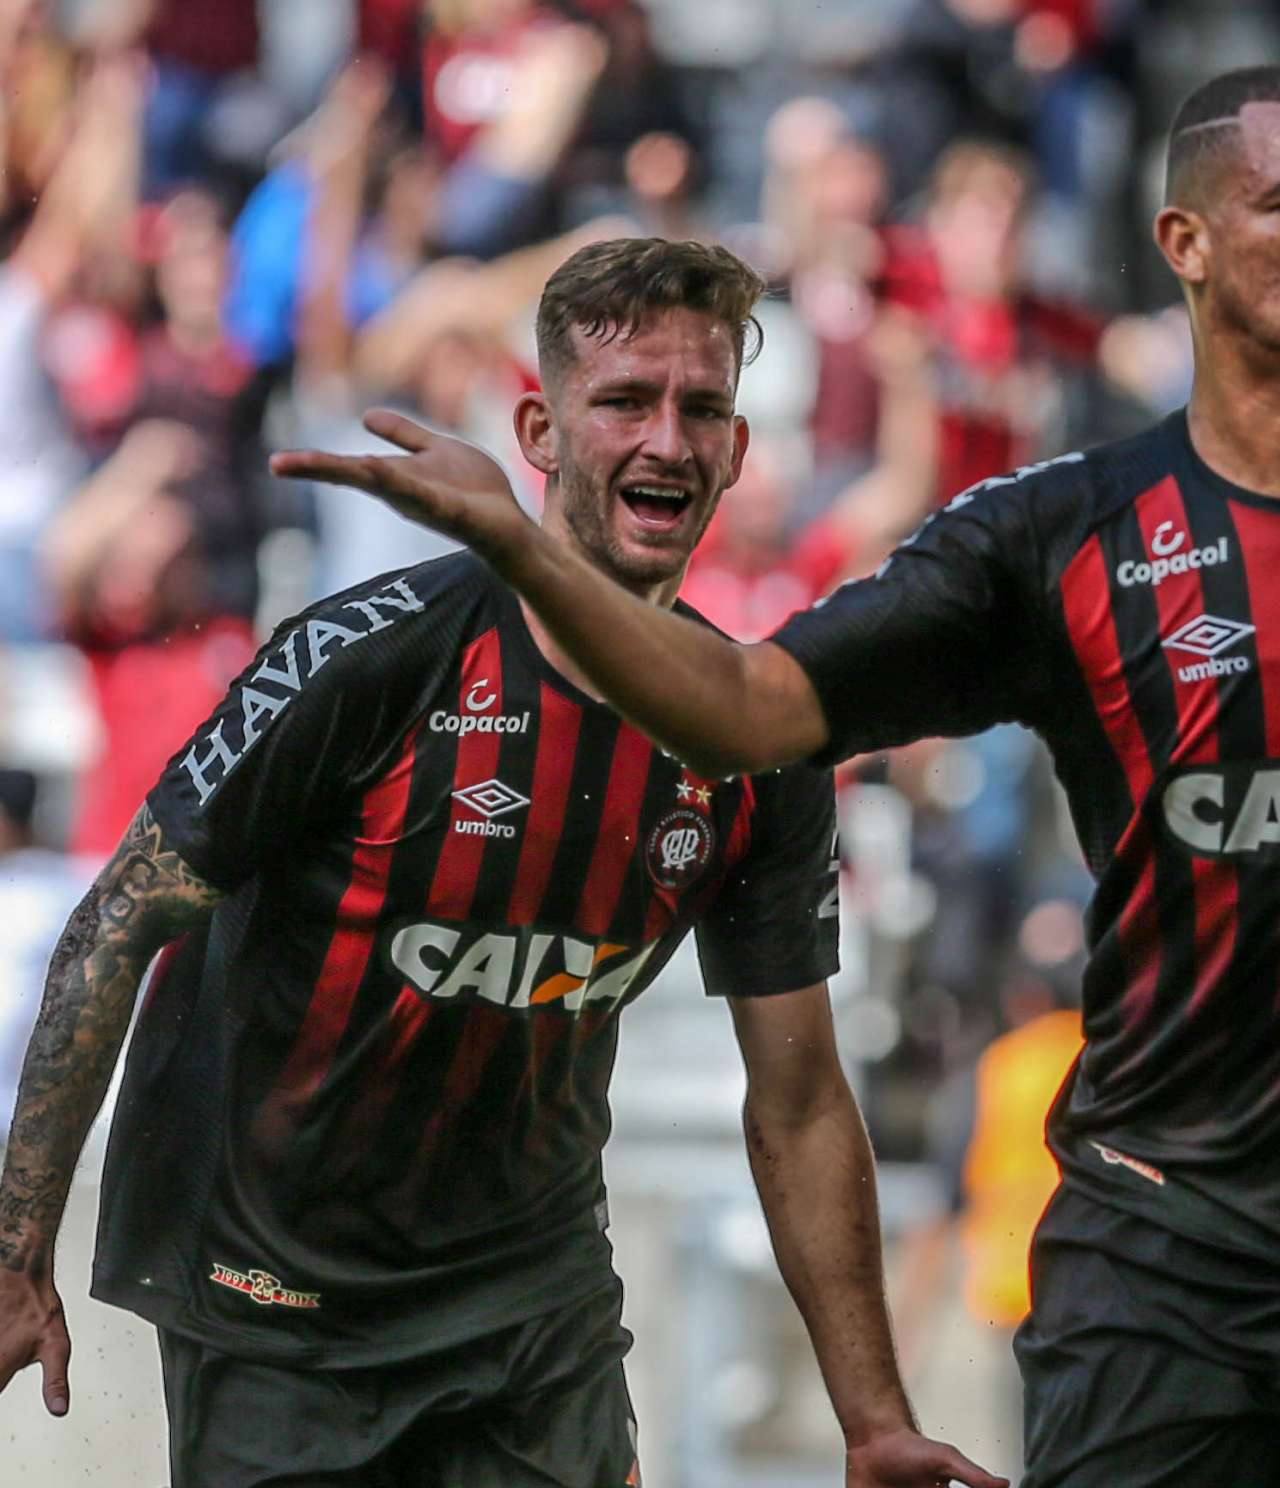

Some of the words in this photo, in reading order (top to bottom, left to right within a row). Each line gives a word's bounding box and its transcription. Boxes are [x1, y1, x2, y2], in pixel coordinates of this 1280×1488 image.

[1116, 537, 1229, 587] Copacol
[1178, 656, 1249, 682] umbro
[180, 577, 425, 806] HAVAN
[429, 711, 530, 737] Copacol
[455, 819, 516, 839] umbro
[219, 1269, 247, 1288] 1997
